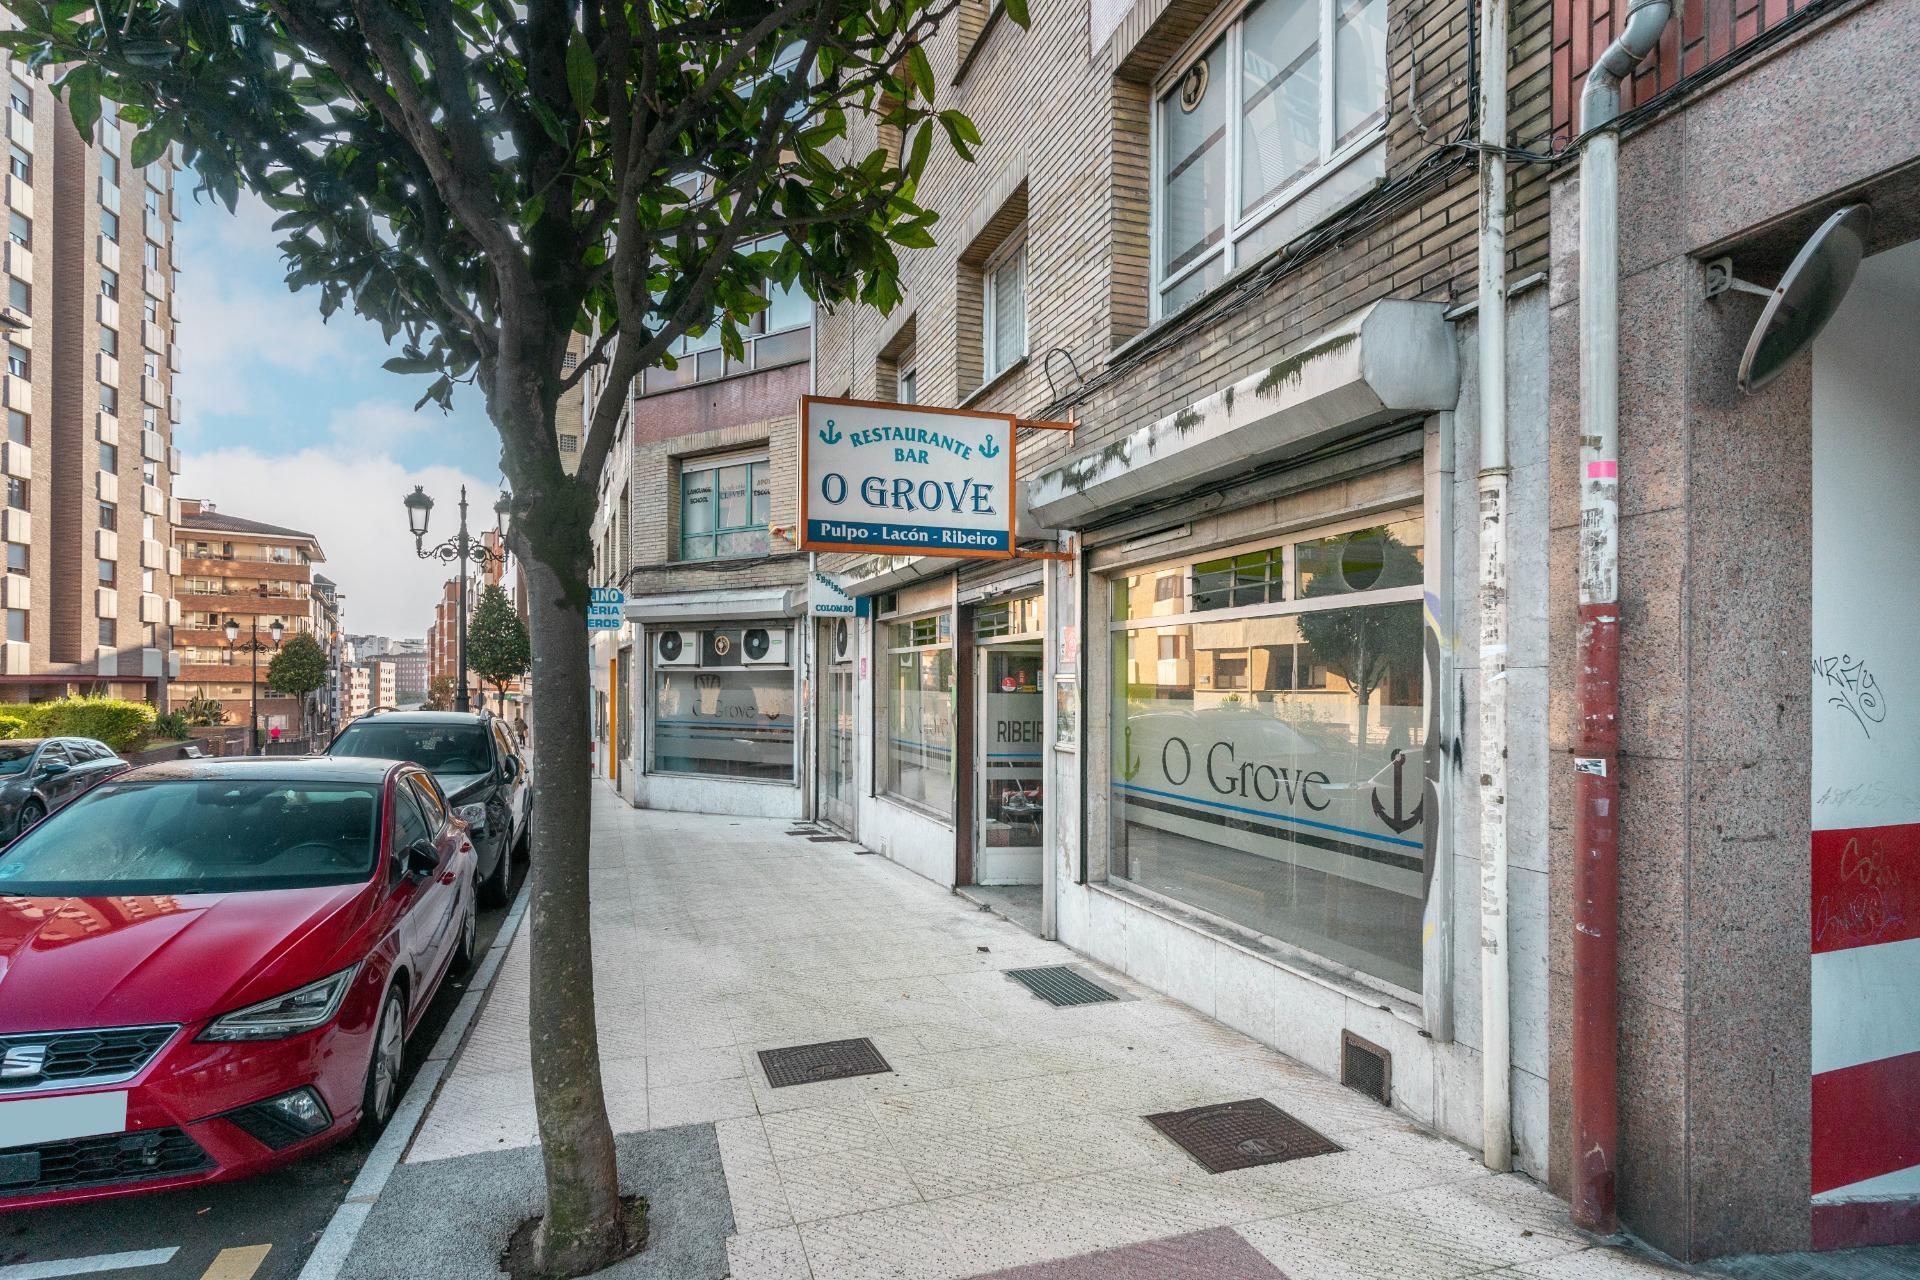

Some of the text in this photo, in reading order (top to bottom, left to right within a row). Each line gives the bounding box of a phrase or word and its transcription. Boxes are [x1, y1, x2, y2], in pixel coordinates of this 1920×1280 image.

[850, 426, 973, 461] RESTAURANTE
[894, 448, 929, 464] BAR
[821, 473, 996, 515] O GROVE
[820, 523, 869, 541] Pulpo
[882, 526, 929, 542] Lacón
[942, 529, 998, 546] Ribeiro
[592, 590, 619, 601] INO
[815, 604, 854, 612] COLOMBO
[1162, 737, 1331, 811] O Grove
